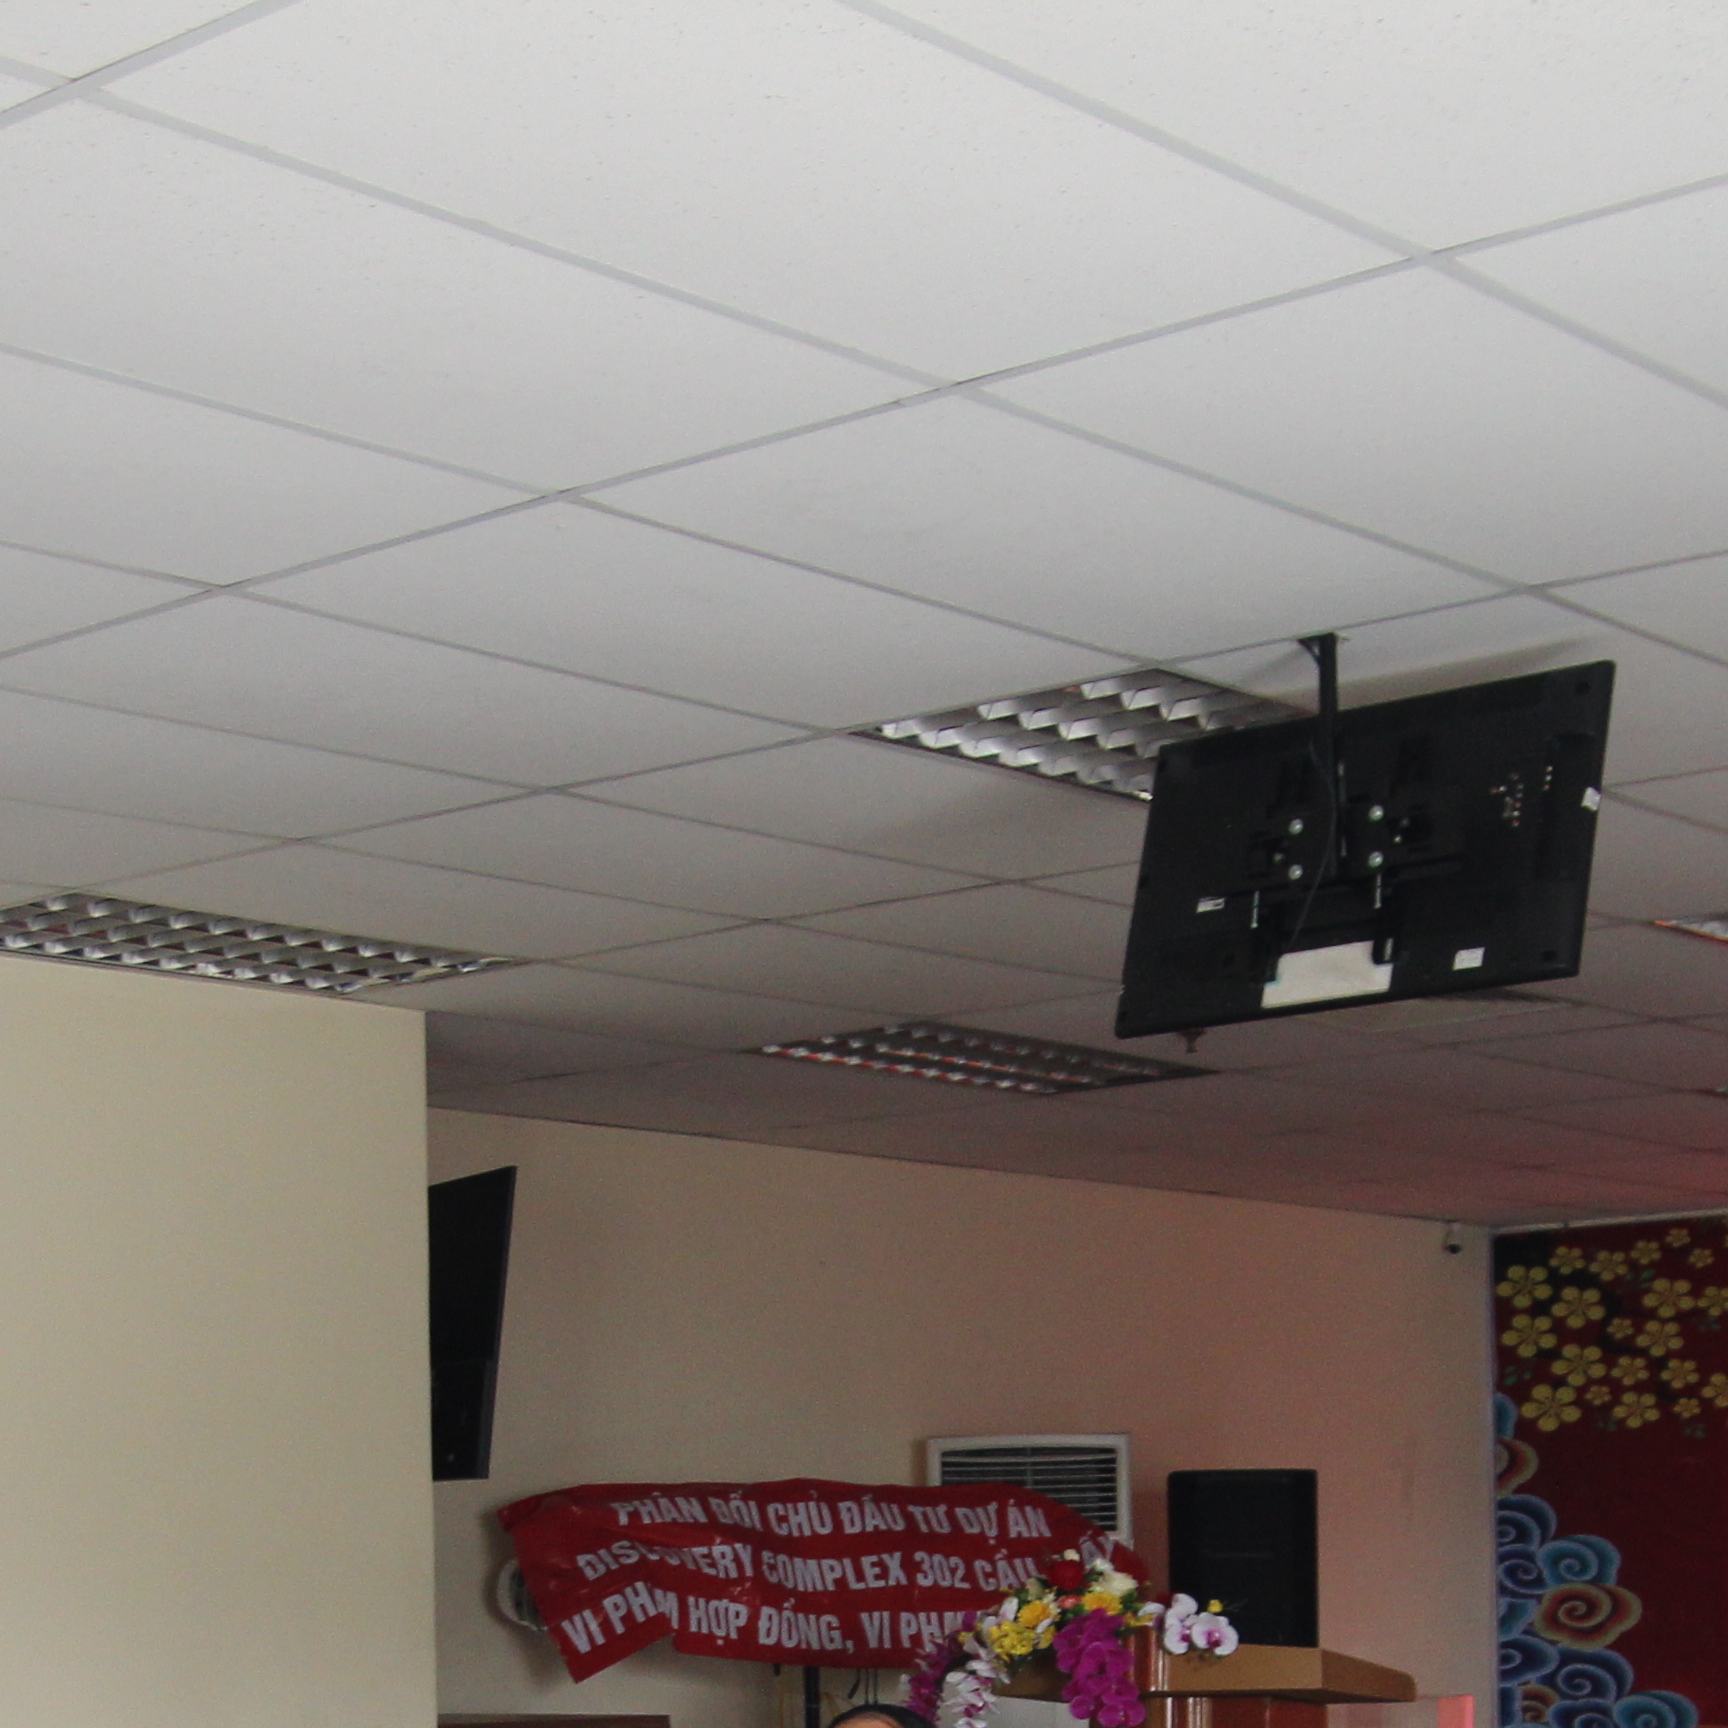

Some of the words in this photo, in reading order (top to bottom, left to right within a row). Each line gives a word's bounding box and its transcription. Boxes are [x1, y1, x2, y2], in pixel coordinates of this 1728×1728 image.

[766, 1489, 834, 1538] CHỦ
[907, 1503, 952, 1534] TƯ
[953, 1501, 1000, 1546] DỰ
[1008, 1498, 1053, 1539] ÁN
[761, 1549, 909, 1593] COMPLEX
[913, 1550, 972, 1590] 302
[560, 1608, 607, 1655] VI
[687, 1594, 750, 1647] HỢP
[860, 1610, 892, 1649] VI
